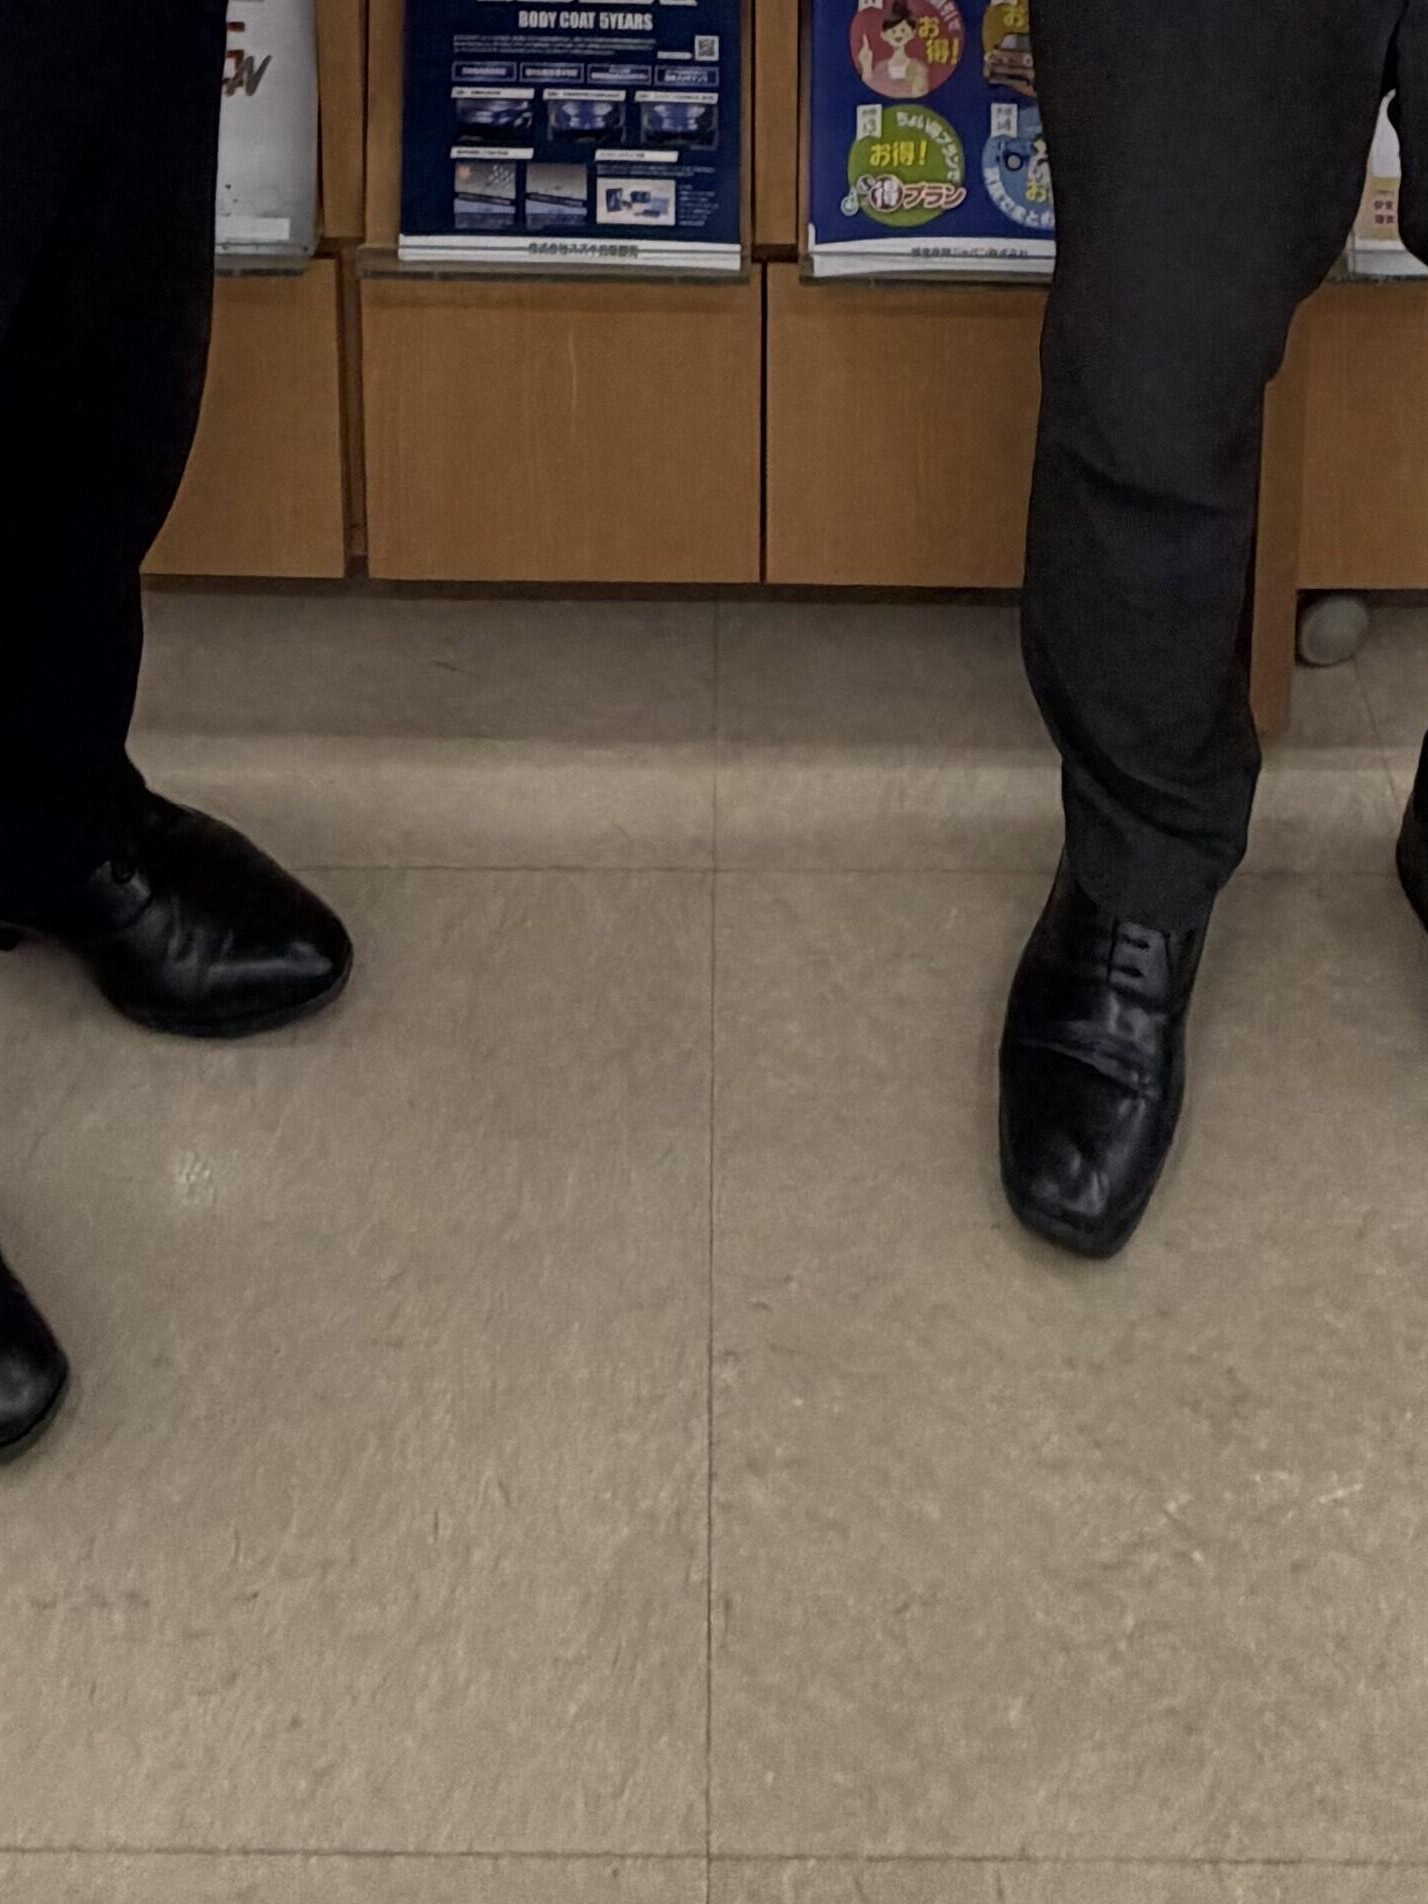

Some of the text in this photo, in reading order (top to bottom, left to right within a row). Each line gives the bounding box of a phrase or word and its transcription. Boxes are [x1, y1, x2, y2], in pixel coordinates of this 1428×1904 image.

[518, 10, 654, 31] BODY COAT 5YEARS
